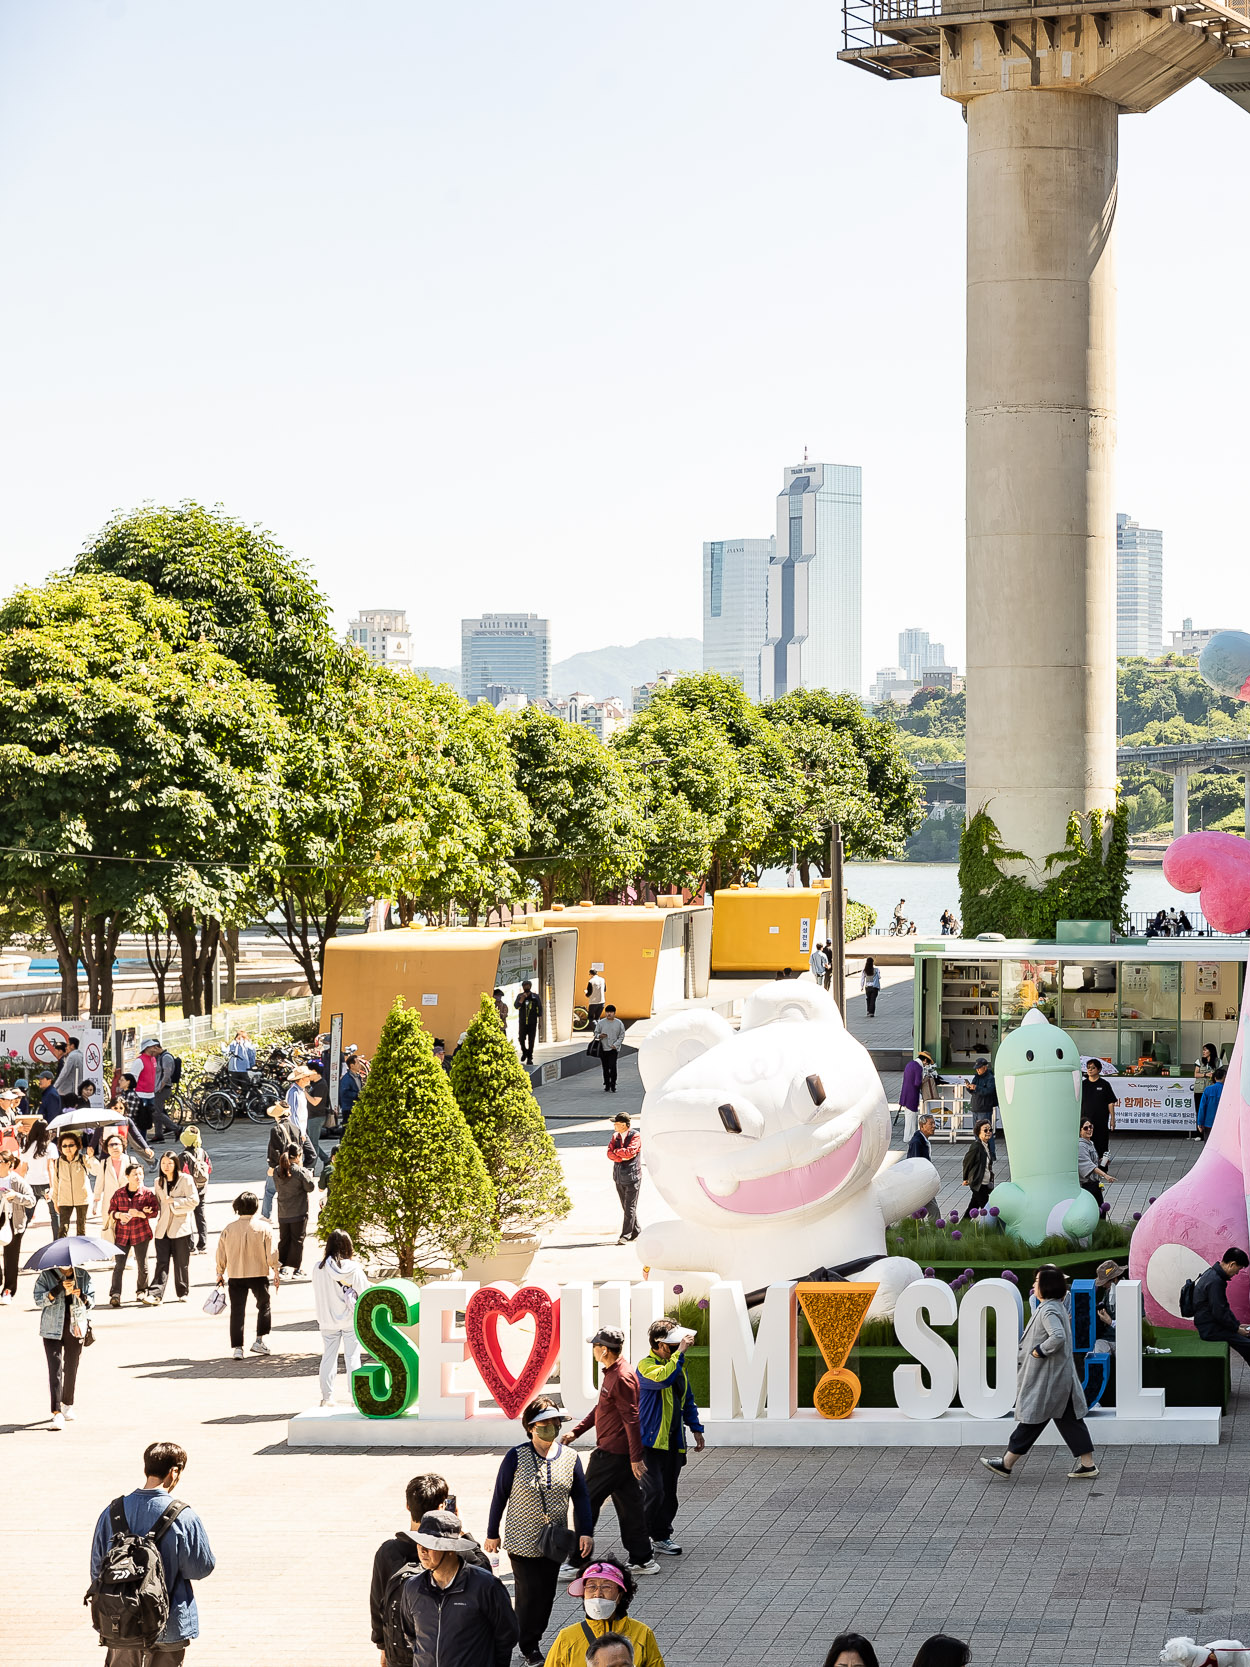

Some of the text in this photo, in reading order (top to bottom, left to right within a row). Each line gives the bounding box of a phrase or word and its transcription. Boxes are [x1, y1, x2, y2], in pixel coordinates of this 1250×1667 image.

[479, 621, 528, 629] GLASS TOWER
[1124, 1097, 1162, 1108] 함께하는
[1164, 1097, 1192, 1108] 이동형
